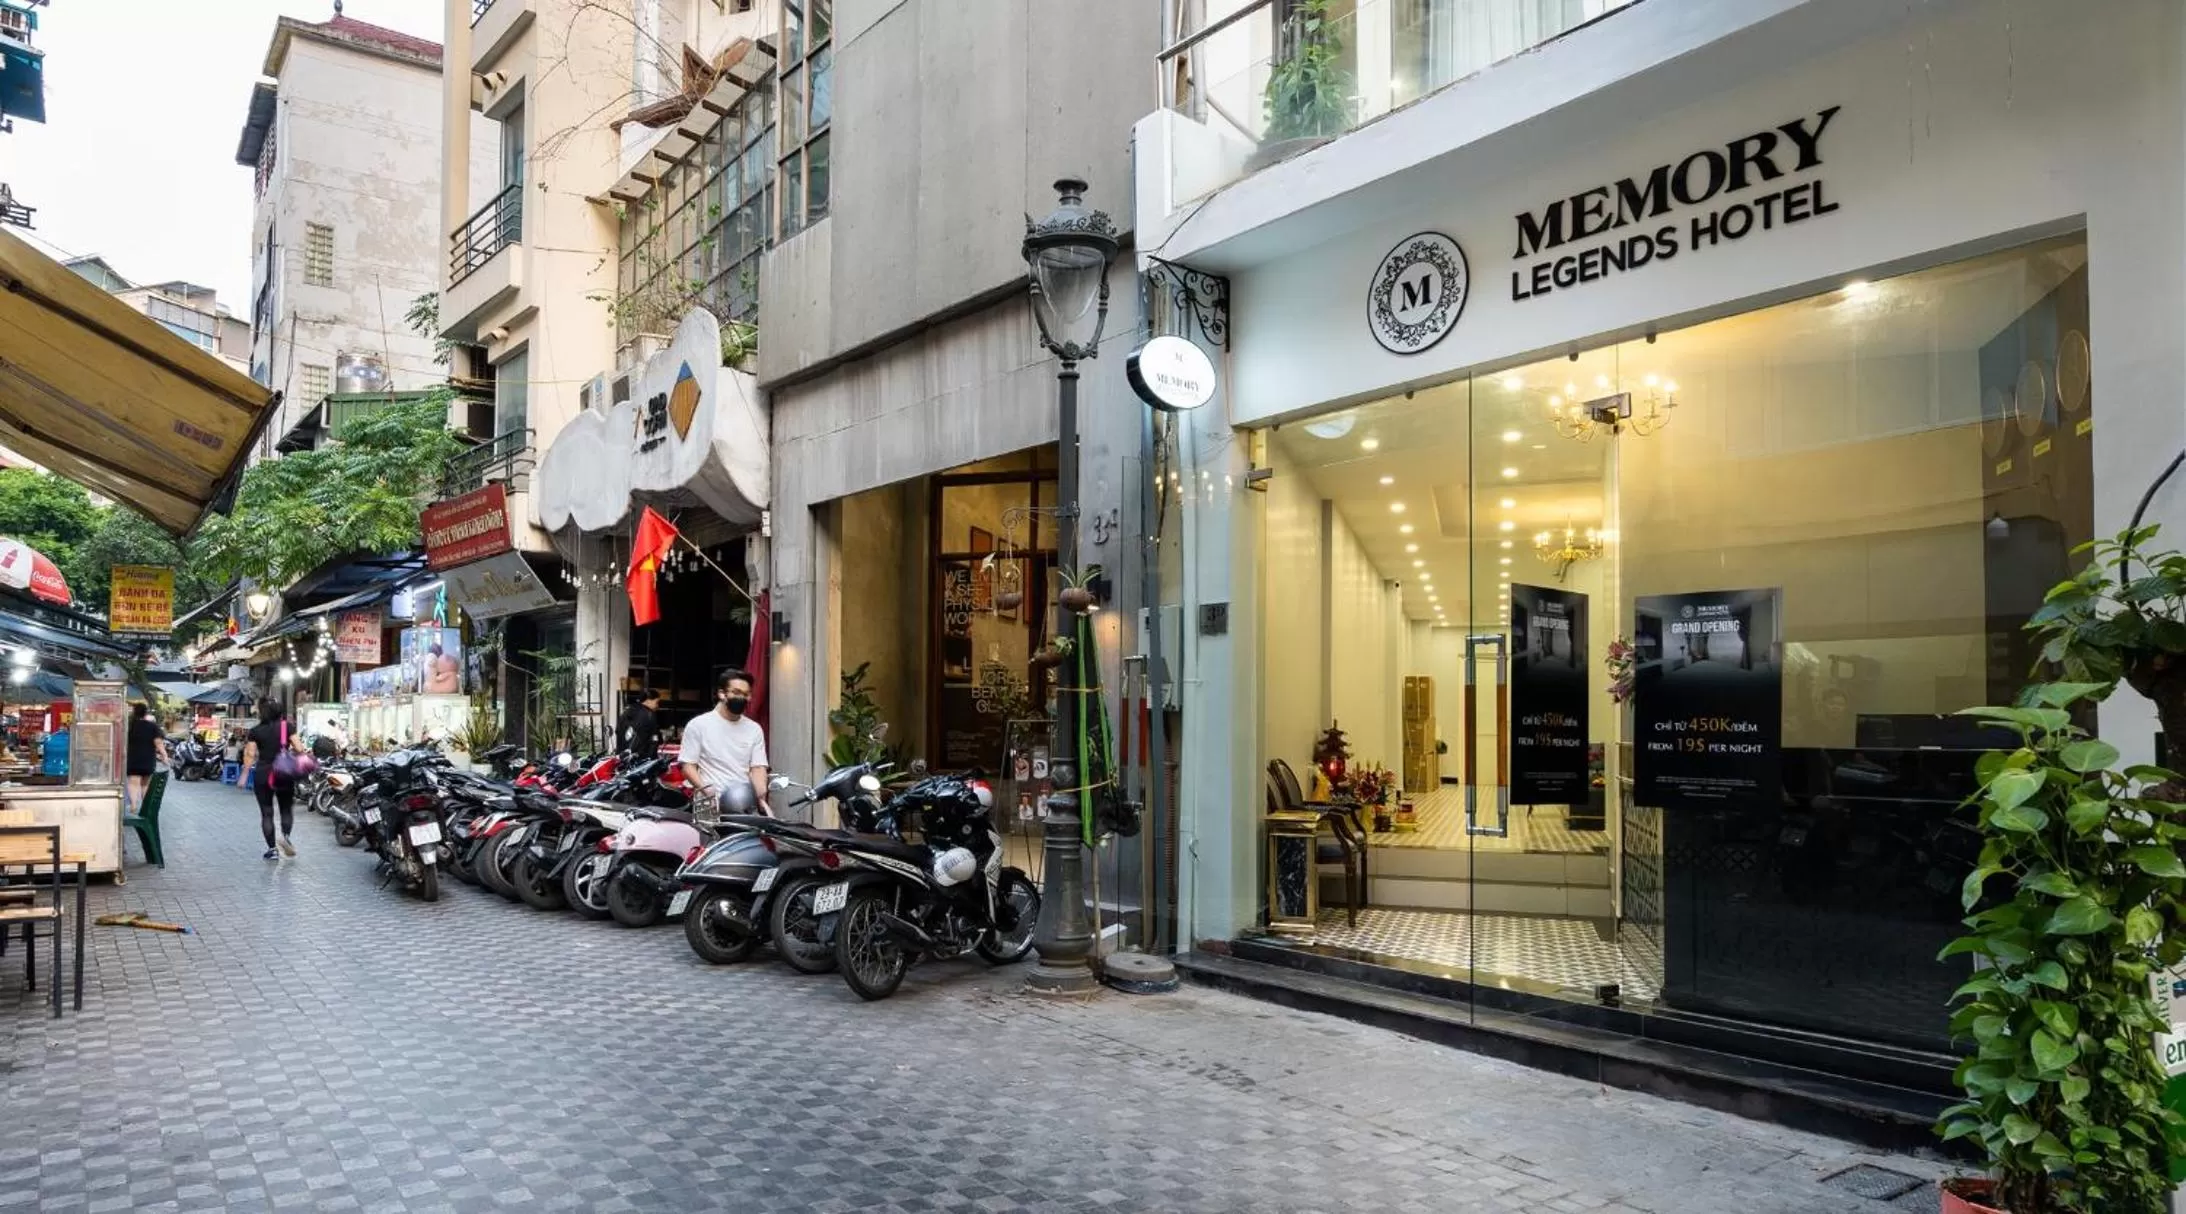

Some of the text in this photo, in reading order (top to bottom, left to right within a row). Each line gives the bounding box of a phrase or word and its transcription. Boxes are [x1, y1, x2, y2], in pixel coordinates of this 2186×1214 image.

[1512, 106, 1841, 259] MEMORY
[1512, 180, 1839, 301] LEGENDS HOTEL
[1399, 274, 1432, 312] M
[945, 569, 968, 583] WE
[1671, 620, 1740, 634] GRAND OPENING
[1648, 741, 1673, 751] FROM
[1709, 744, 1727, 753] PER
[1729, 744, 1763, 753] NIGHT
